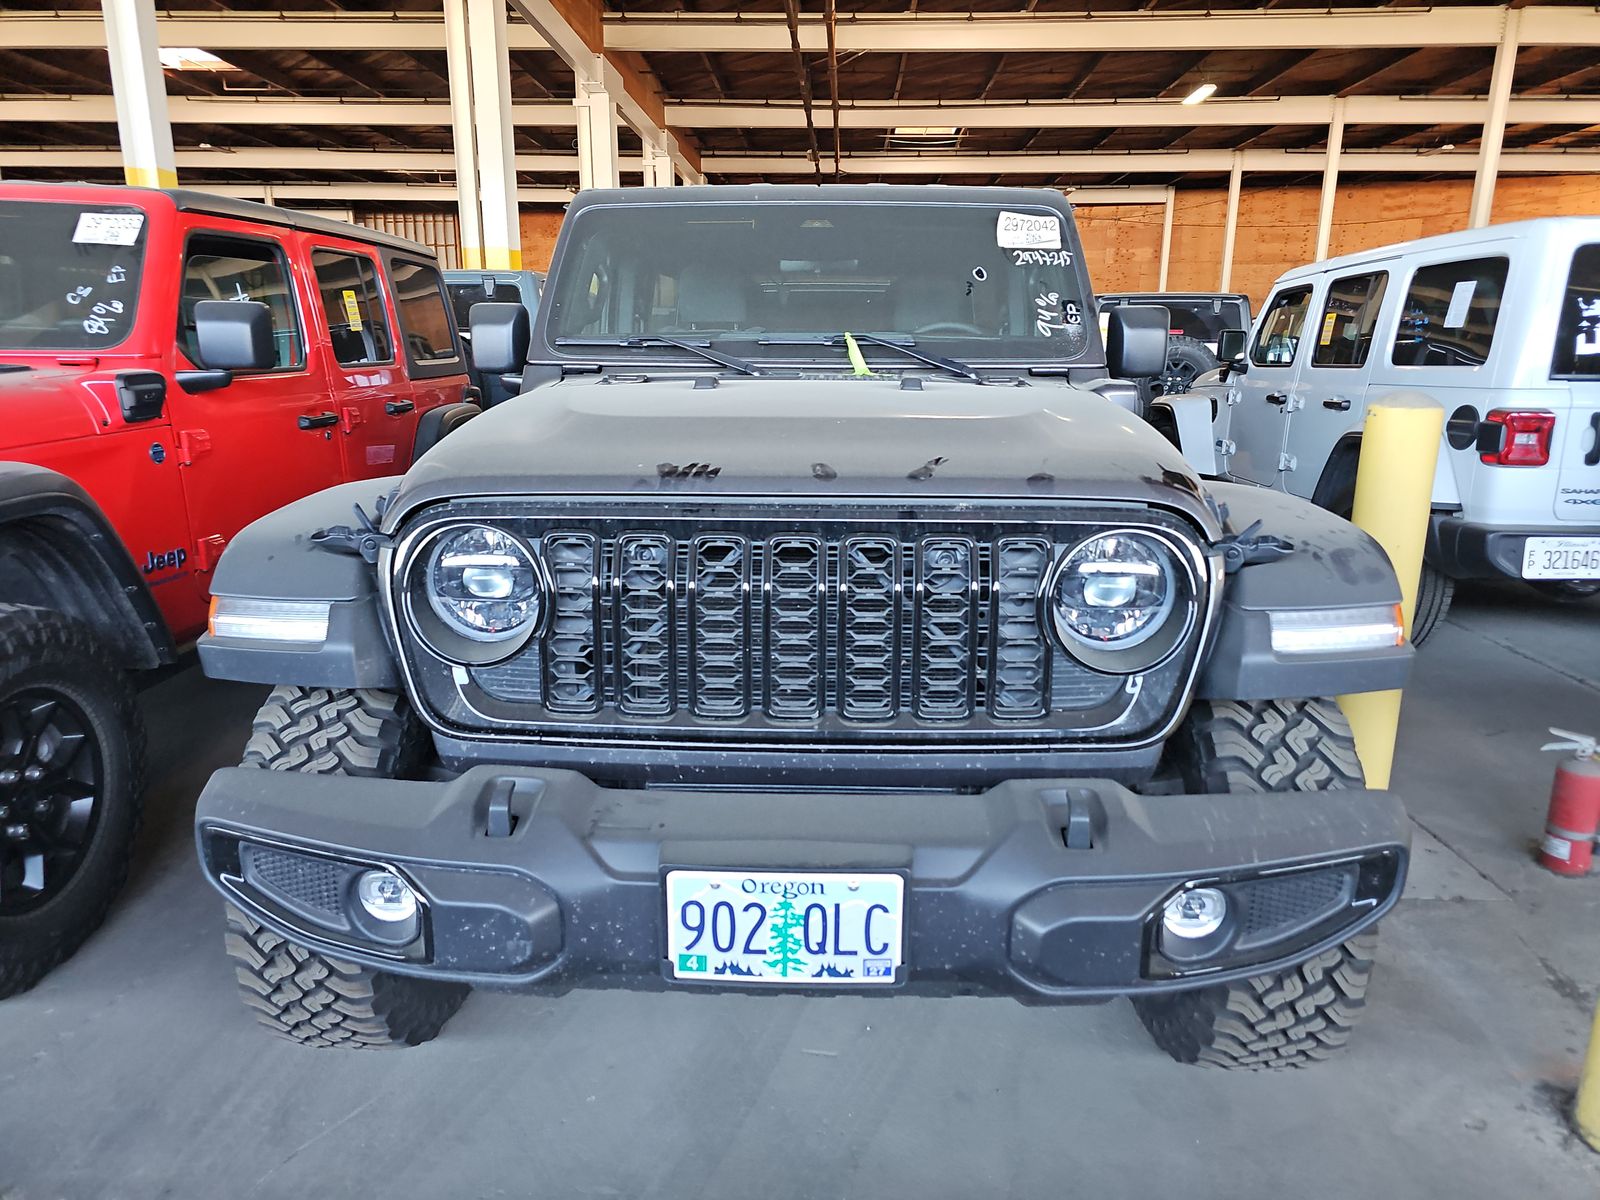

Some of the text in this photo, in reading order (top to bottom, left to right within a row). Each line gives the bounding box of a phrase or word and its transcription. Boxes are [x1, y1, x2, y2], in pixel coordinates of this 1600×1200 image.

[1003, 216, 1057, 232] 2972042
[142, 548, 187, 575] Jeep
[741, 878, 826, 900] Oregon
[680, 900, 891, 956] 902 QLC
[686, 955, 700, 970] 4
